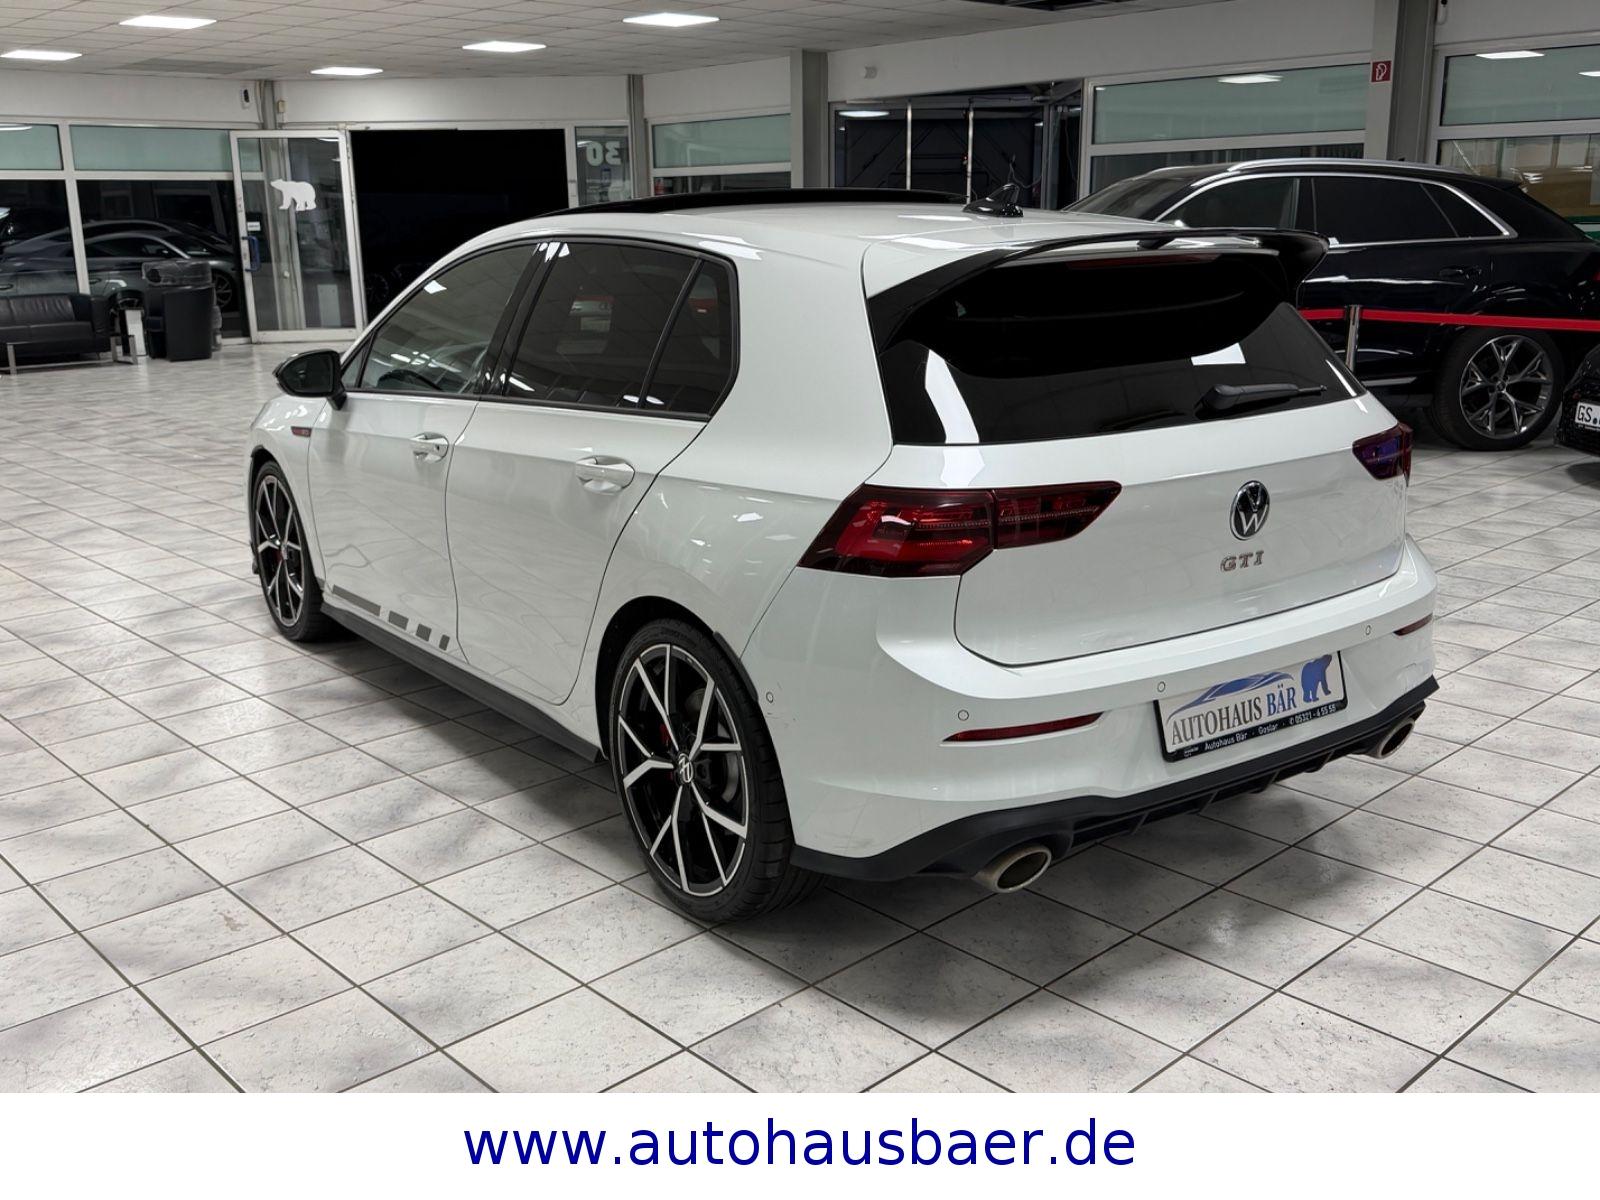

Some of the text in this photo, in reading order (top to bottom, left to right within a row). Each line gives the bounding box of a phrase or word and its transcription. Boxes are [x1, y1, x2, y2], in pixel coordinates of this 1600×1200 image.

[1578, 405, 1593, 422] GS
[1220, 550, 1264, 571] GTI
[1172, 683, 1297, 745] AUTOHAUS BÄR
[1204, 736, 1235, 751] Autohaus
